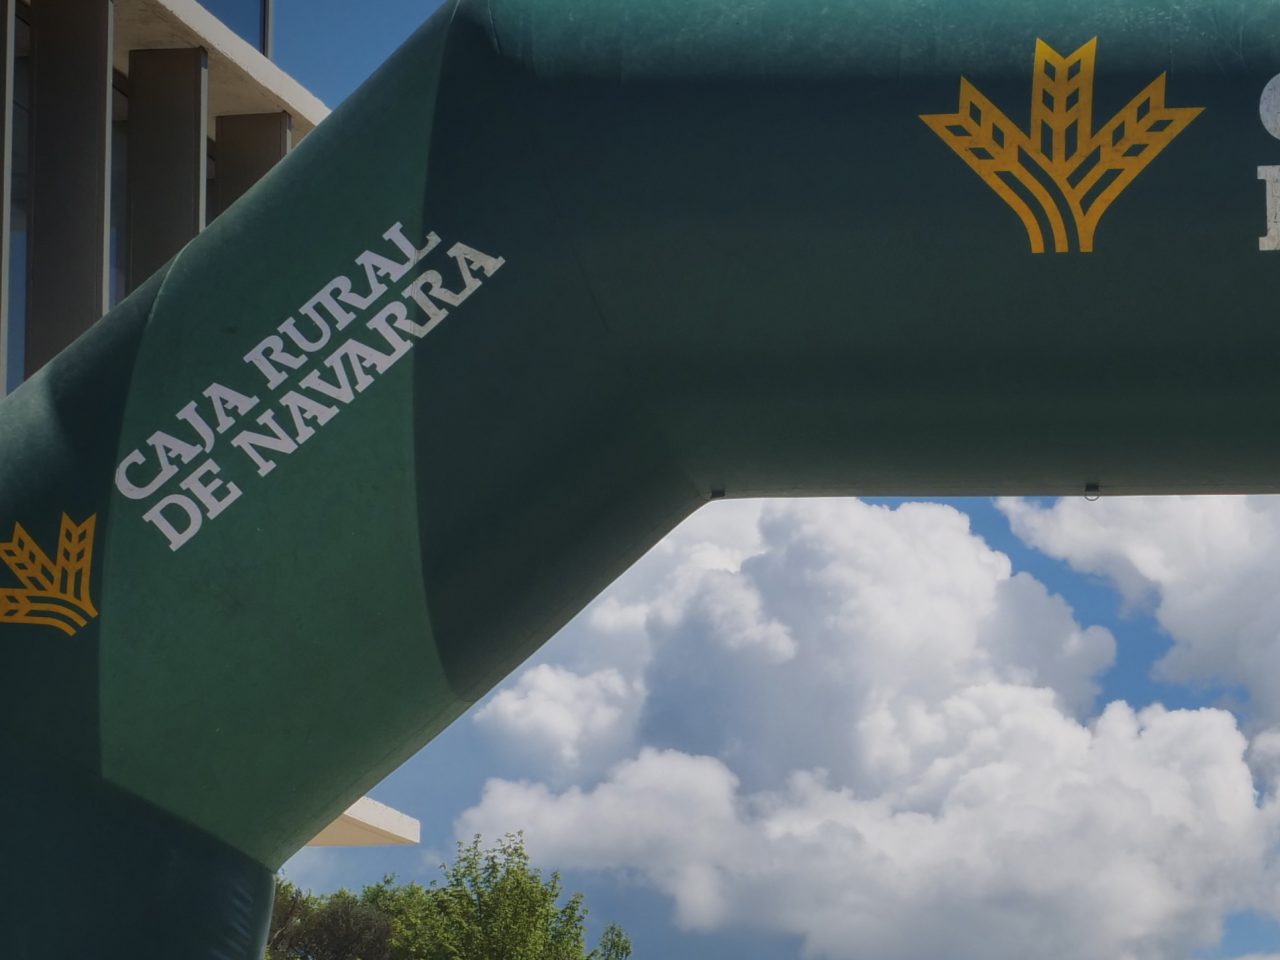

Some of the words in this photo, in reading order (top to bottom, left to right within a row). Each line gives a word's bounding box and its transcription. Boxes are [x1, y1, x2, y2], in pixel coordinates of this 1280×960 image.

[115, 382, 260, 499] CAJA
[243, 222, 442, 390] RURAL
[142, 458, 243, 552] DE
[231, 242, 506, 477] NAVARRA
